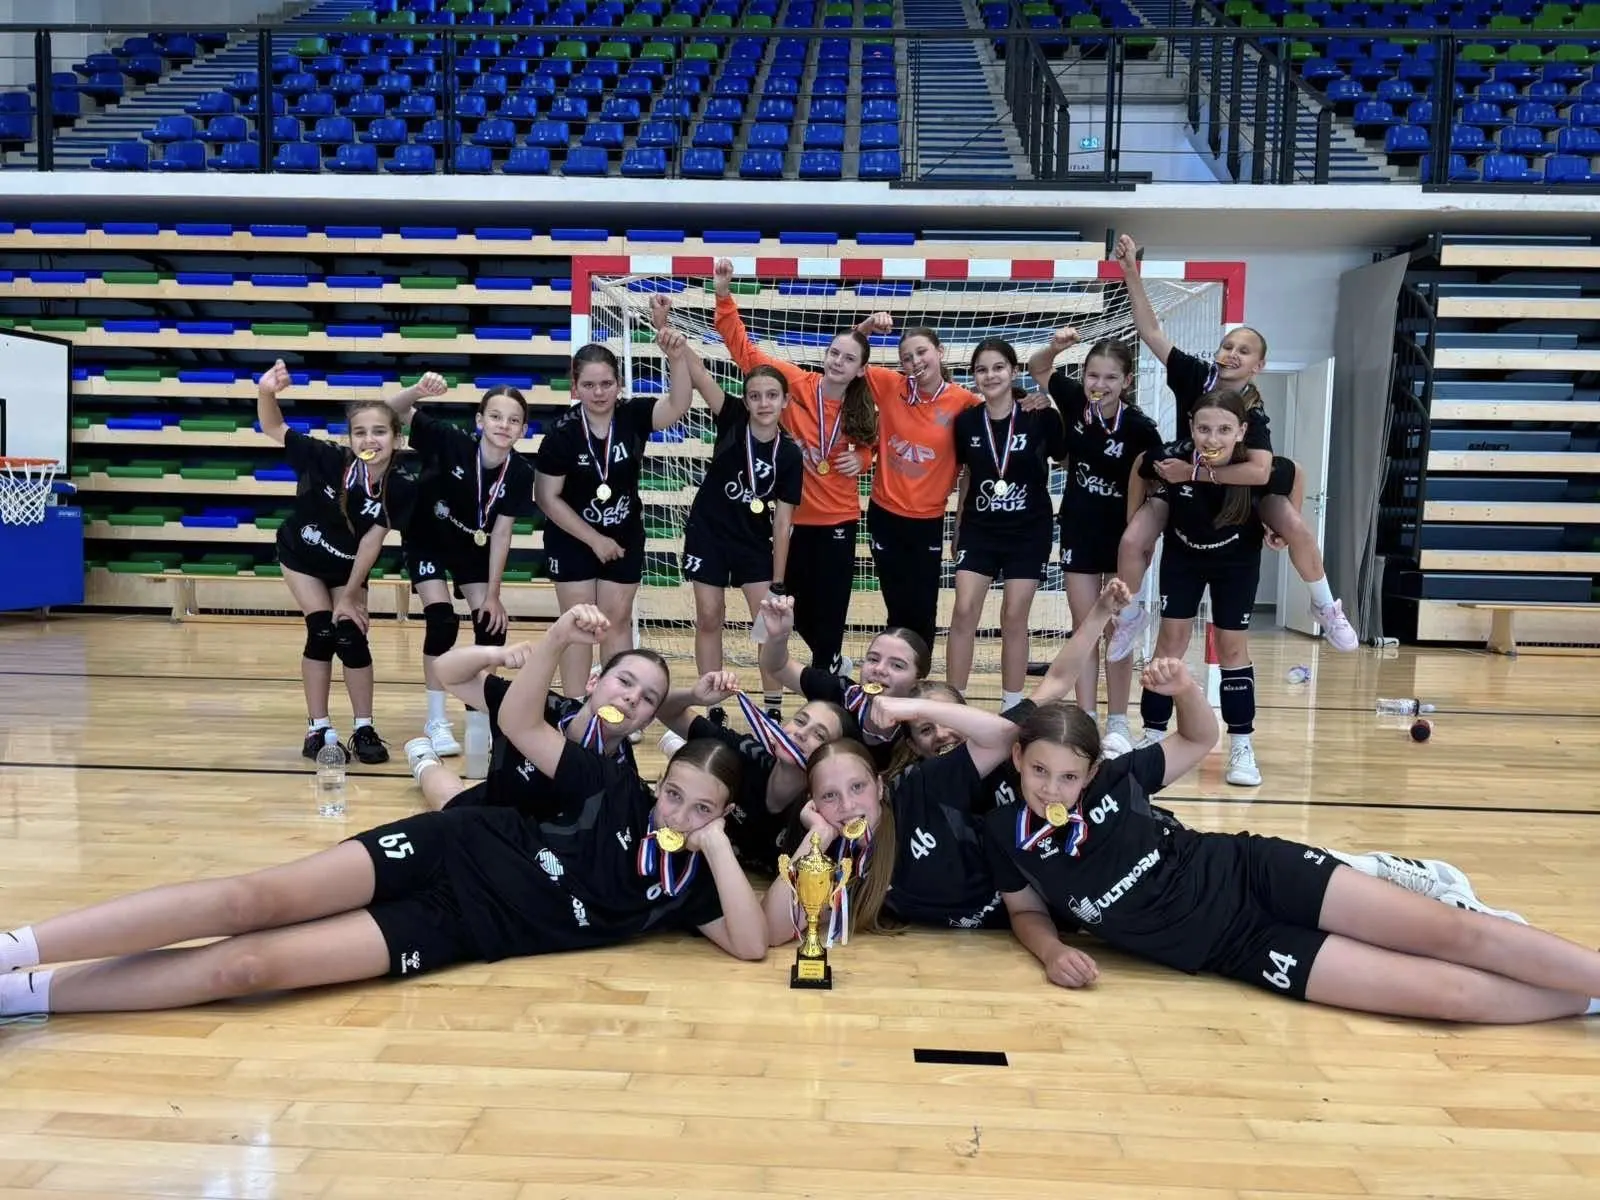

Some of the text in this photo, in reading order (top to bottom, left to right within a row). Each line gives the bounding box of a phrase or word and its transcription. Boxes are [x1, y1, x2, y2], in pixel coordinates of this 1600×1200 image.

[1010, 433, 1027, 451] 23
[1104, 439, 1124, 458] 24
[613, 442, 628, 463] 21
[754, 458, 773, 478] 33
[360, 498, 381, 518] 34
[991, 500, 1027, 512] PUZ
[419, 561, 435, 576] 66
[684, 554, 703, 572] 33
[378, 832, 415, 859] 65
[910, 827, 937, 860] 46
[1262, 950, 1298, 990] 64
